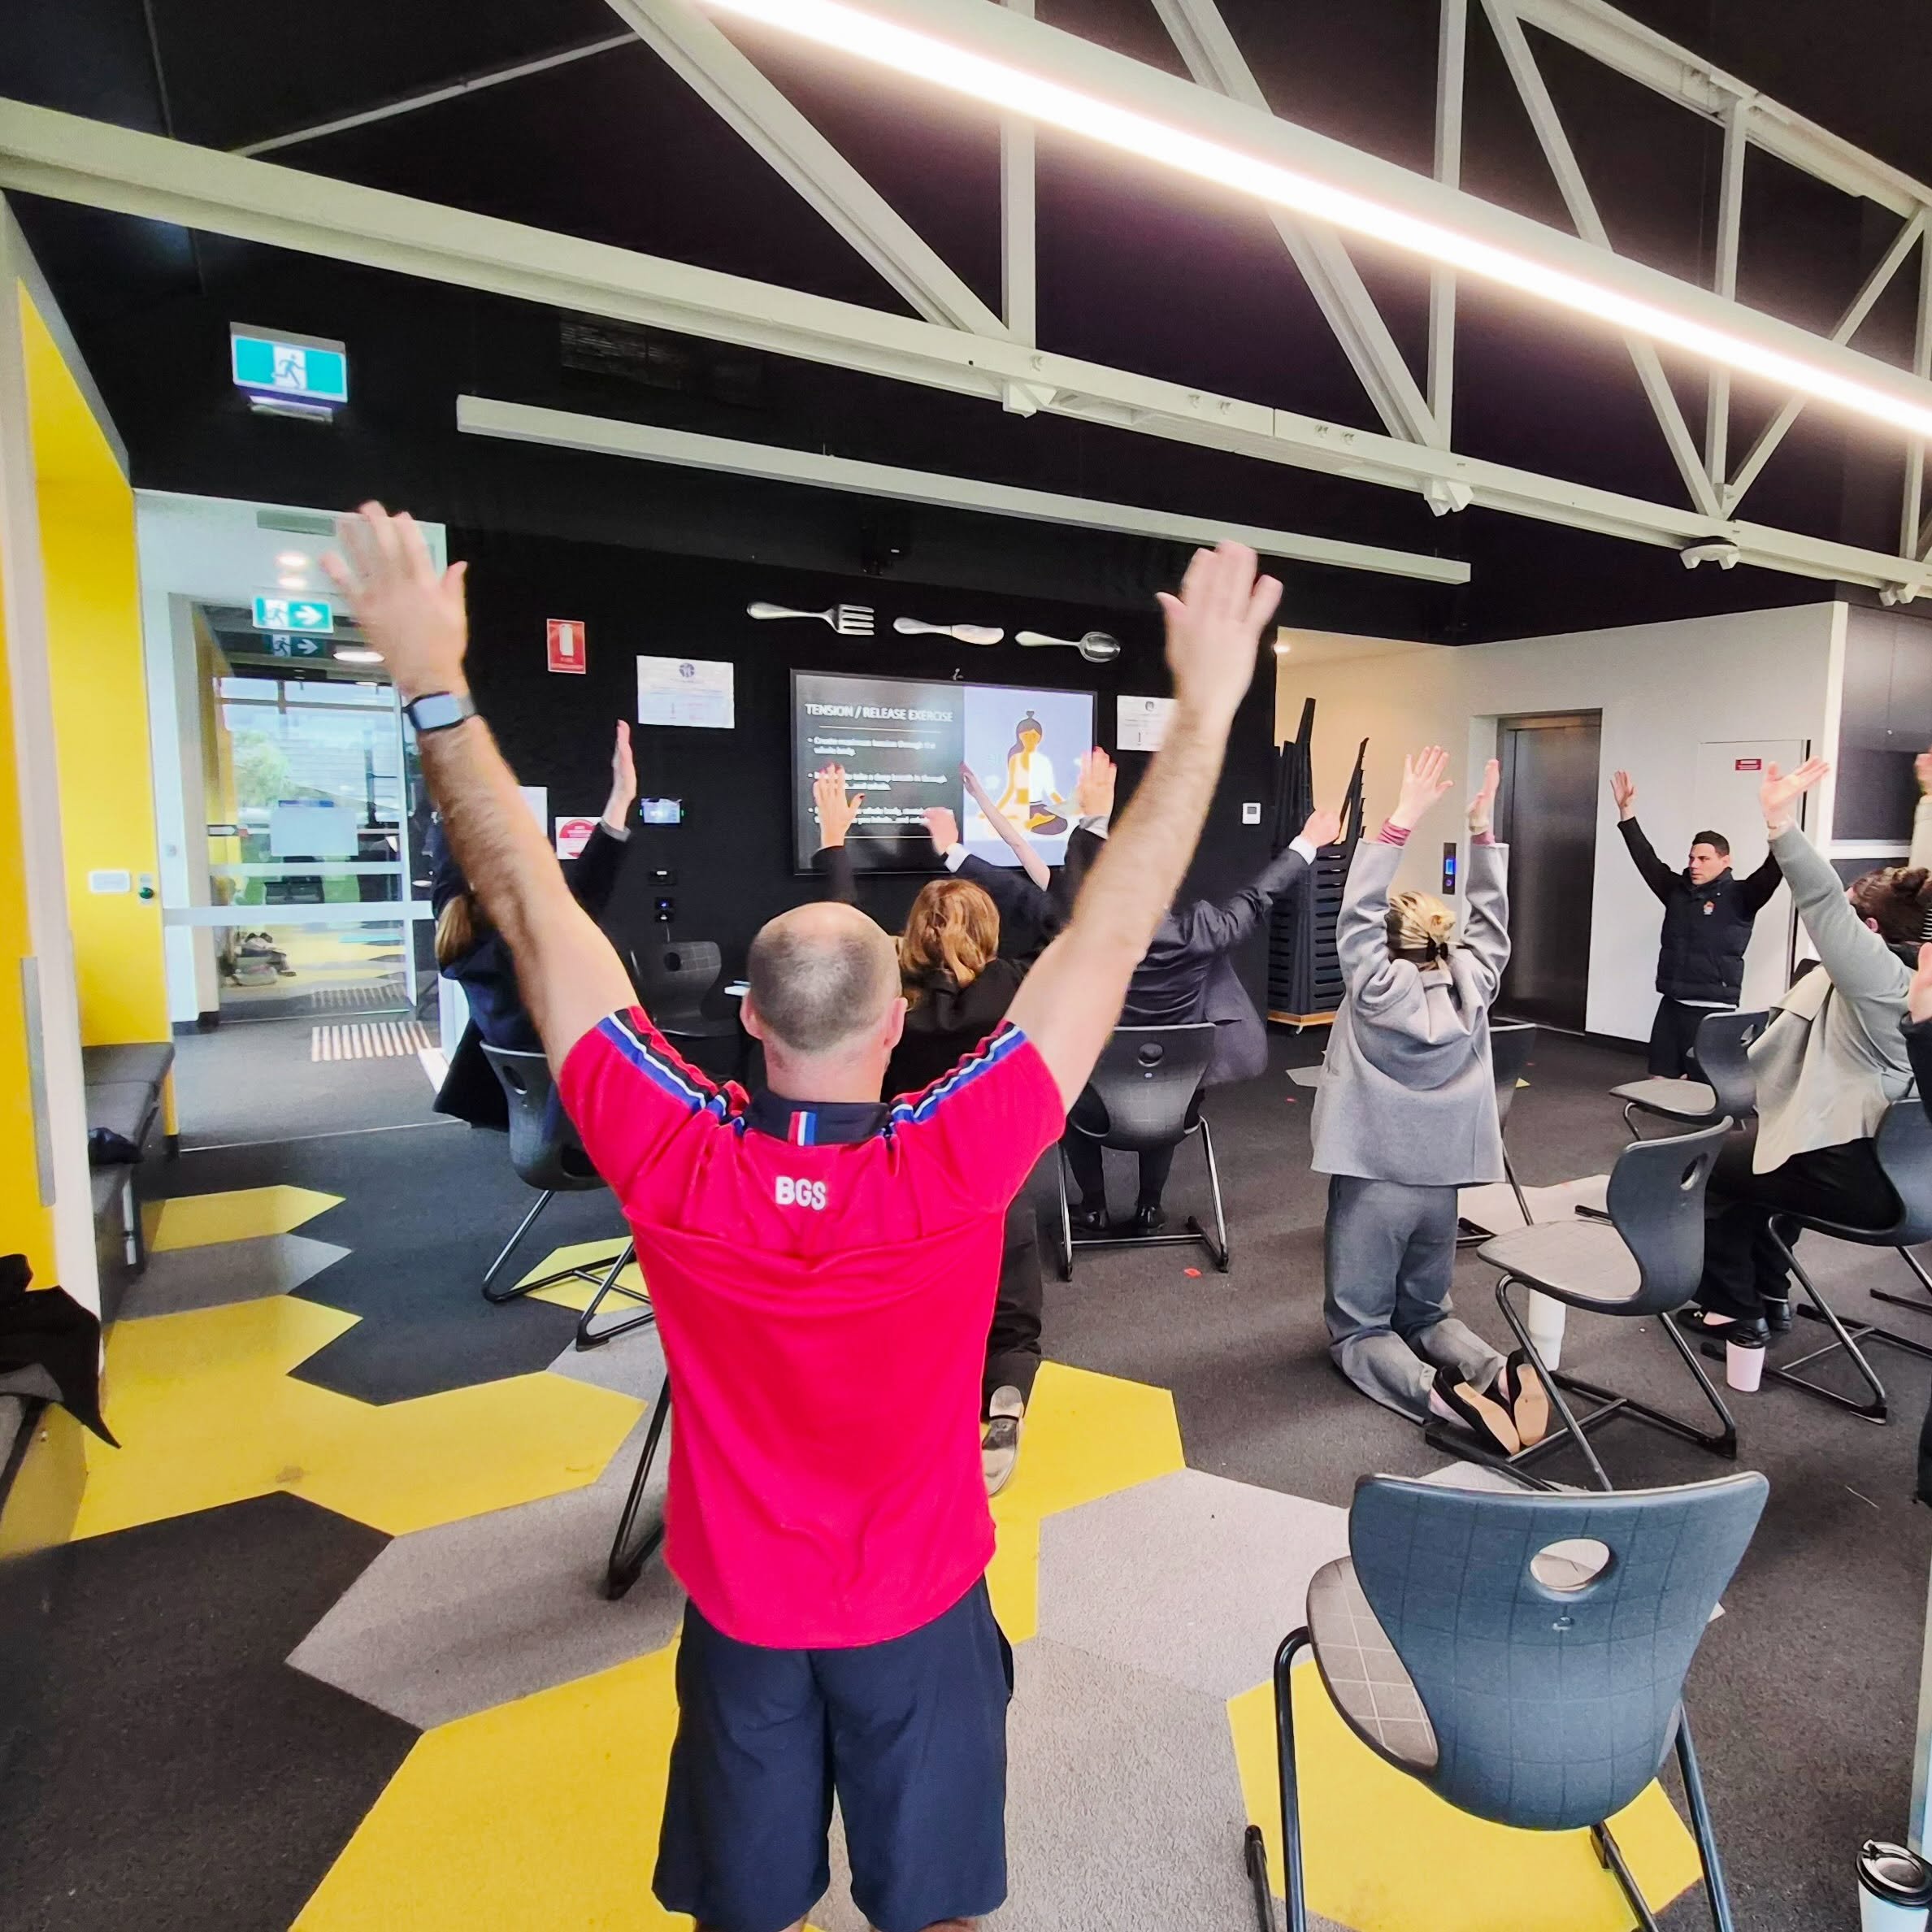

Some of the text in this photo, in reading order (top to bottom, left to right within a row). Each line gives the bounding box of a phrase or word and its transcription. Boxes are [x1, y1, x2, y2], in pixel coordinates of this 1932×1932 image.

[805, 703, 953, 723] TENSION / RELEASE EXERCISE
[775, 1175, 826, 1211] BGS
